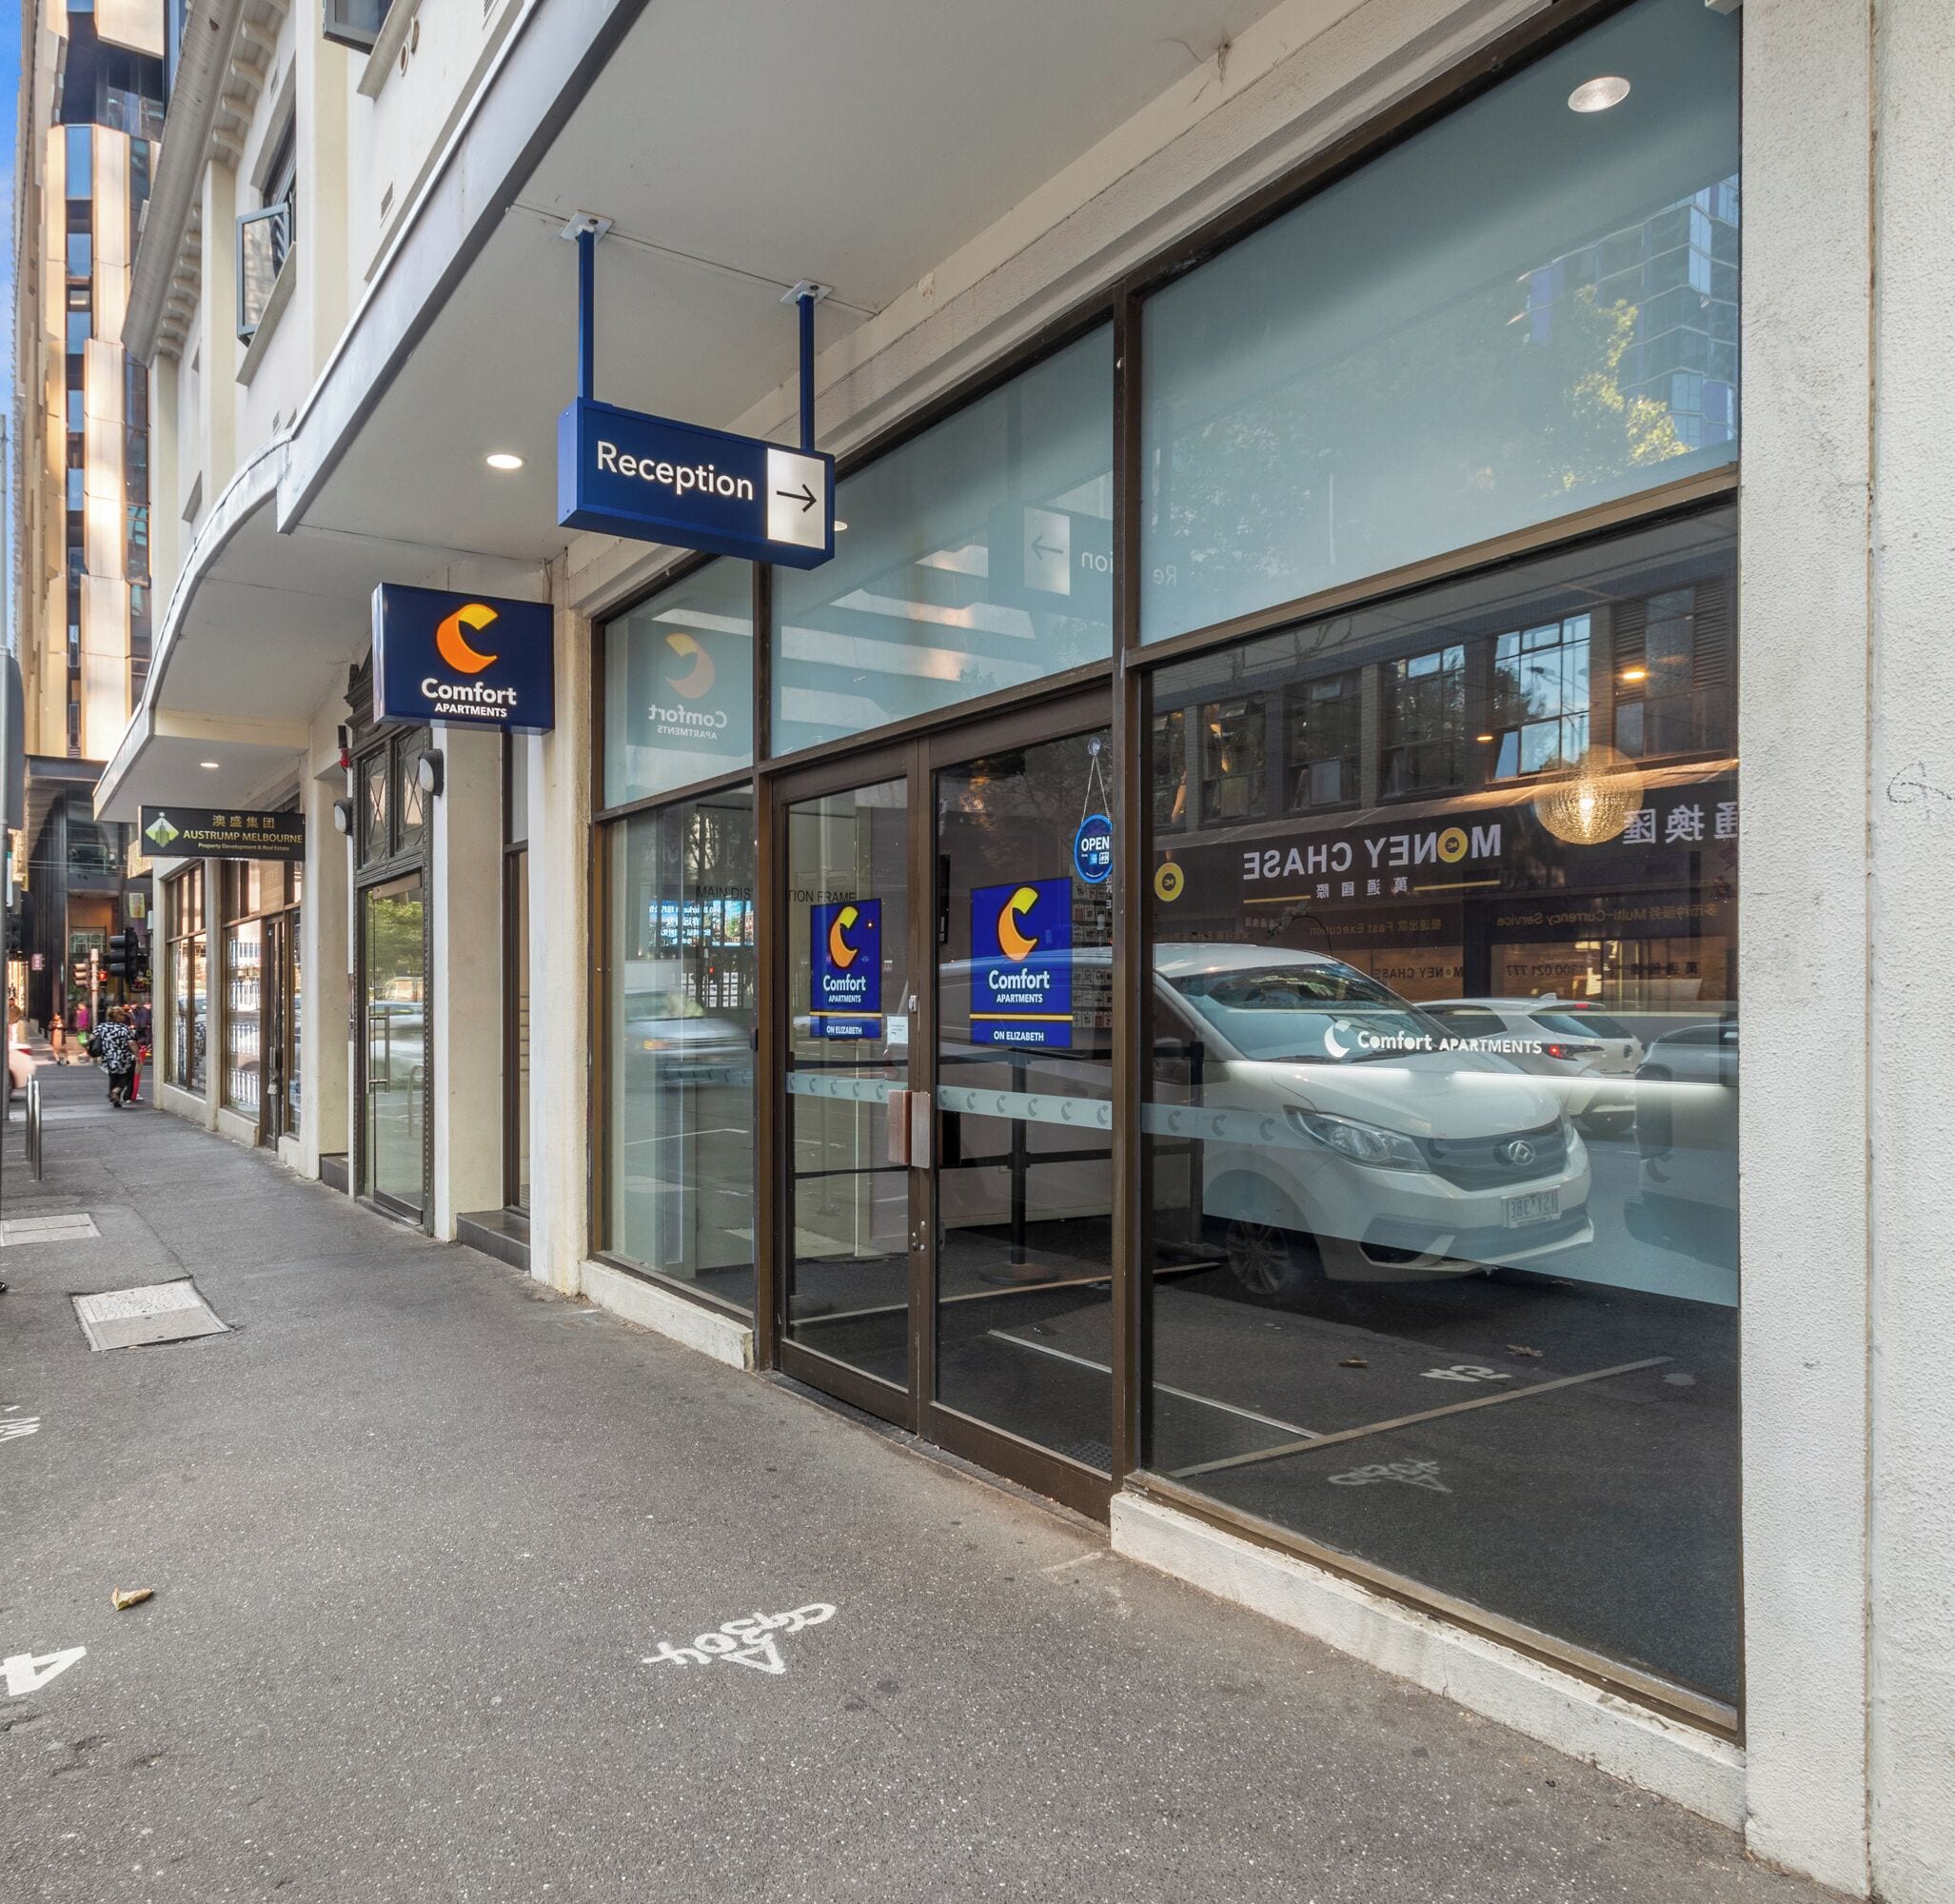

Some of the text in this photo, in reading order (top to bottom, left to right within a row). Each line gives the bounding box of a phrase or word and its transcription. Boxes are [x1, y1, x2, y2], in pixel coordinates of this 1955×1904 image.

[597, 440, 754, 501] Reception
[421, 677, 517, 706] Comfort
[434, 703, 507, 718] APARTMENTS
[212, 814, 275, 829] 澳盛集团
[183, 829, 304, 843] AUSTRUMP MELBOURNE
[222, 843, 257, 851] Development
[1081, 836, 1110, 852] OPEN
[697, 885, 727, 899] MAIN
[818, 890, 856, 902] FRAME
[823, 973, 866, 992] Comfort
[988, 967, 1050, 990] Comfort
[828, 994, 861, 1003] APARTMENTS
[996, 993, 1043, 1003] APARTMENTS
[826, 1025, 862, 1036] ON ELIZABETH
[993, 1030, 1044, 1041] ON ELIZABETH
[1357, 1030, 1542, 1055] Comfort APARTMENTS
